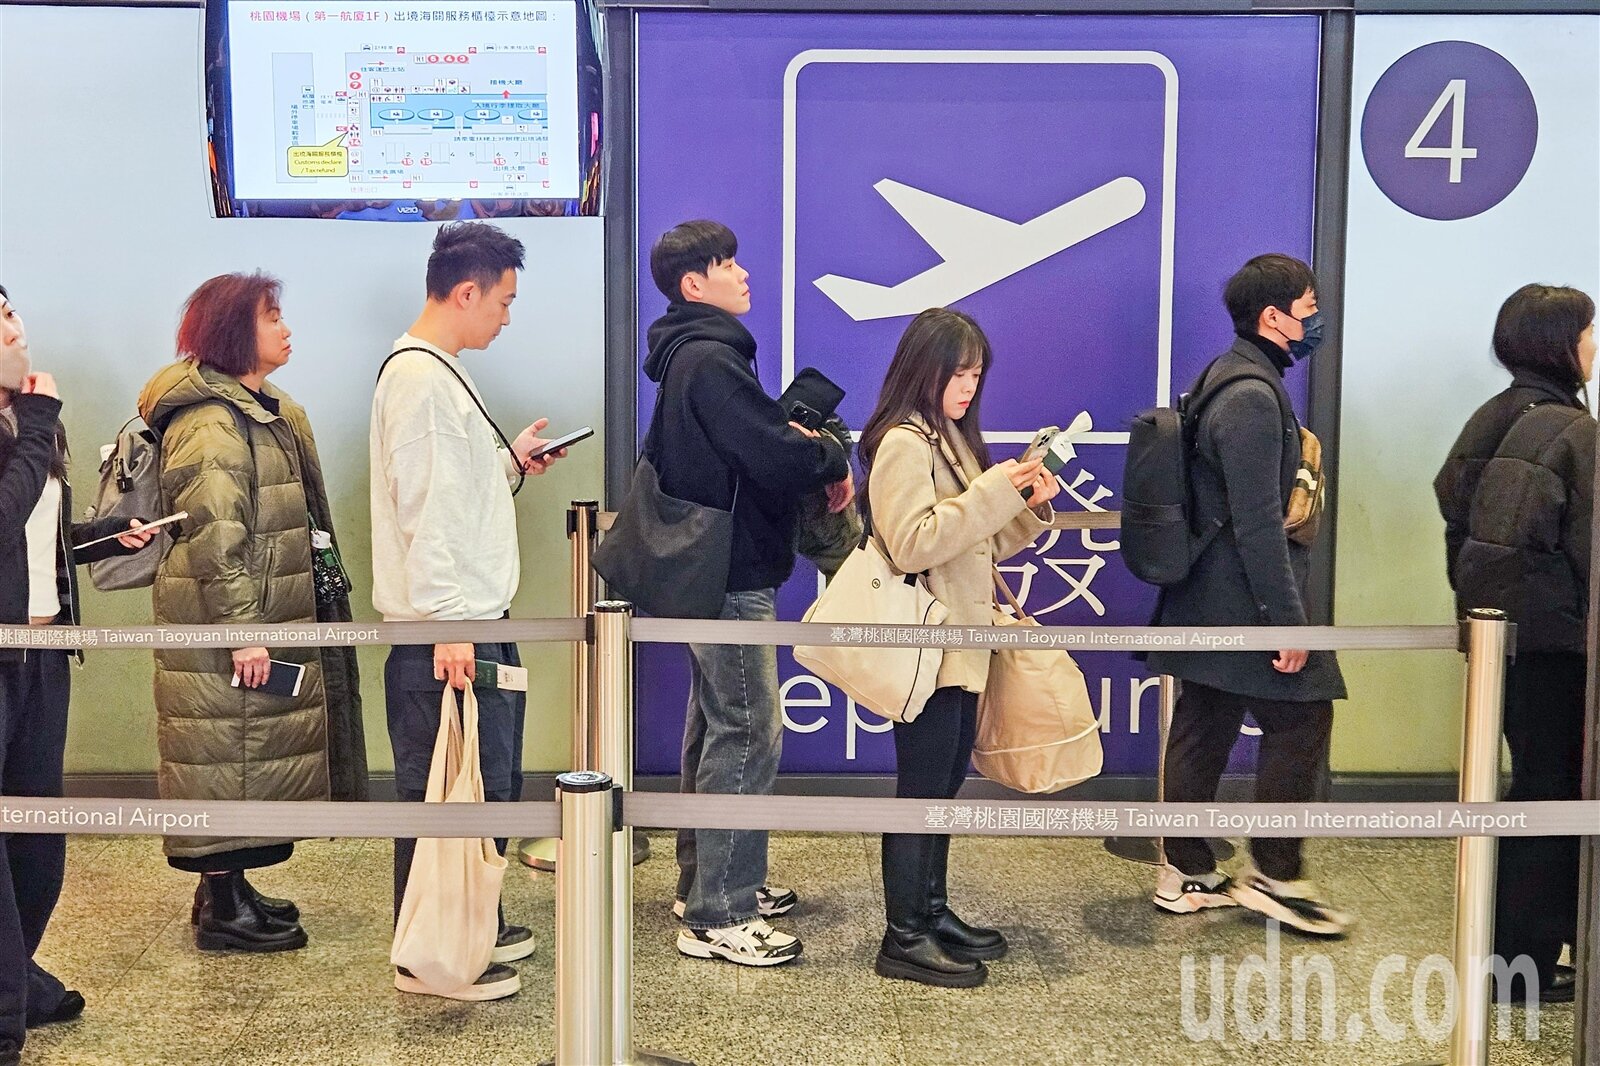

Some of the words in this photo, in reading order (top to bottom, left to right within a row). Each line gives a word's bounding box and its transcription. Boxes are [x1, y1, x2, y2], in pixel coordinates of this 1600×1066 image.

[1405, 79, 1477, 183] 4
[101, 628, 154, 643] Taiwan
[157, 628, 221, 646] Taoyuan
[226, 627, 320, 642] International
[325, 627, 379, 644] Airport
[830, 626, 963, 645] 臺灣桃園國際機場
[967, 628, 1018, 643] Taiwan
[1022, 629, 1085, 647] Taoyuan
[1091, 631, 1186, 646] International
[1190, 632, 1245, 649] Airport
[129, 806, 210, 832] Airport
[925, 805, 1119, 831] 臺灣桃園國際機場
[1124, 807, 1199, 828] Taiwan
[1205, 808, 1296, 832] Taoyuan
[1304, 809, 1442, 829] International
[1449, 809, 1527, 833] Airport
